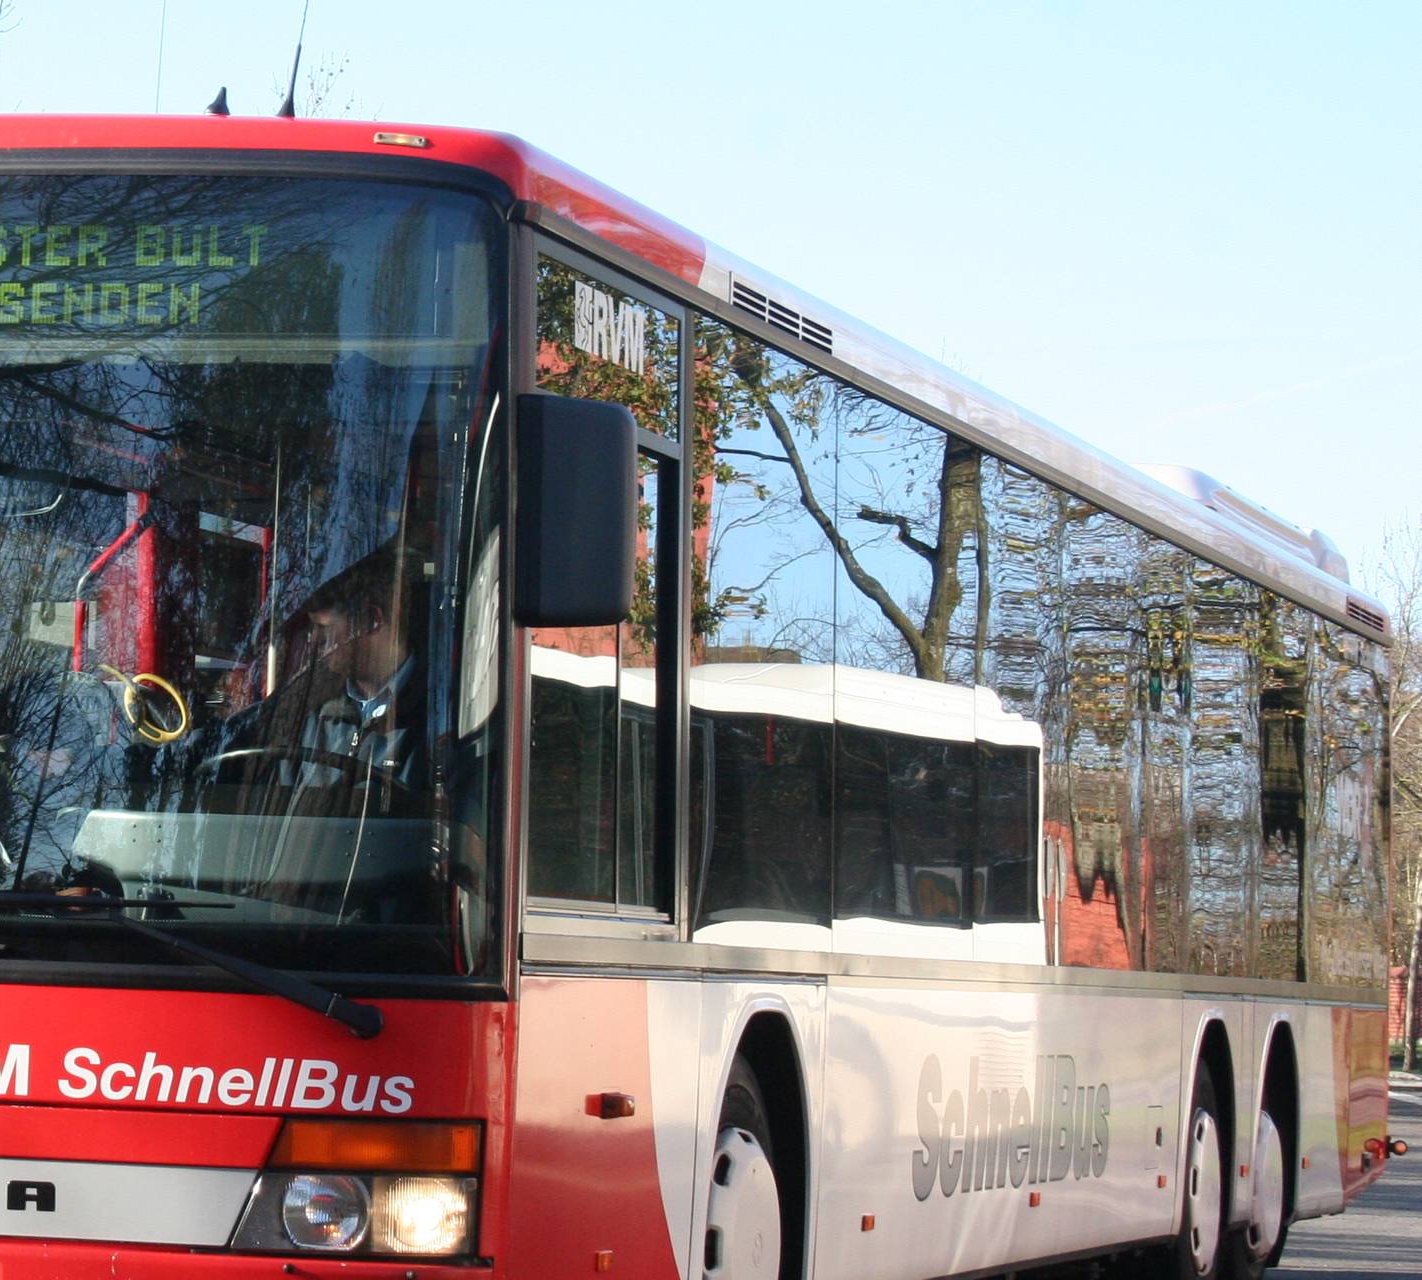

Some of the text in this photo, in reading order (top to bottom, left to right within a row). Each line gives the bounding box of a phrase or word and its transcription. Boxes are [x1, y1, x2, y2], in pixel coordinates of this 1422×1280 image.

[136, 224, 268, 267] BÜLT
[593, 288, 644, 375] RVM
[57, 1047, 415, 1114] SchnellBus
[911, 1053, 1111, 1202] SchnellBus
